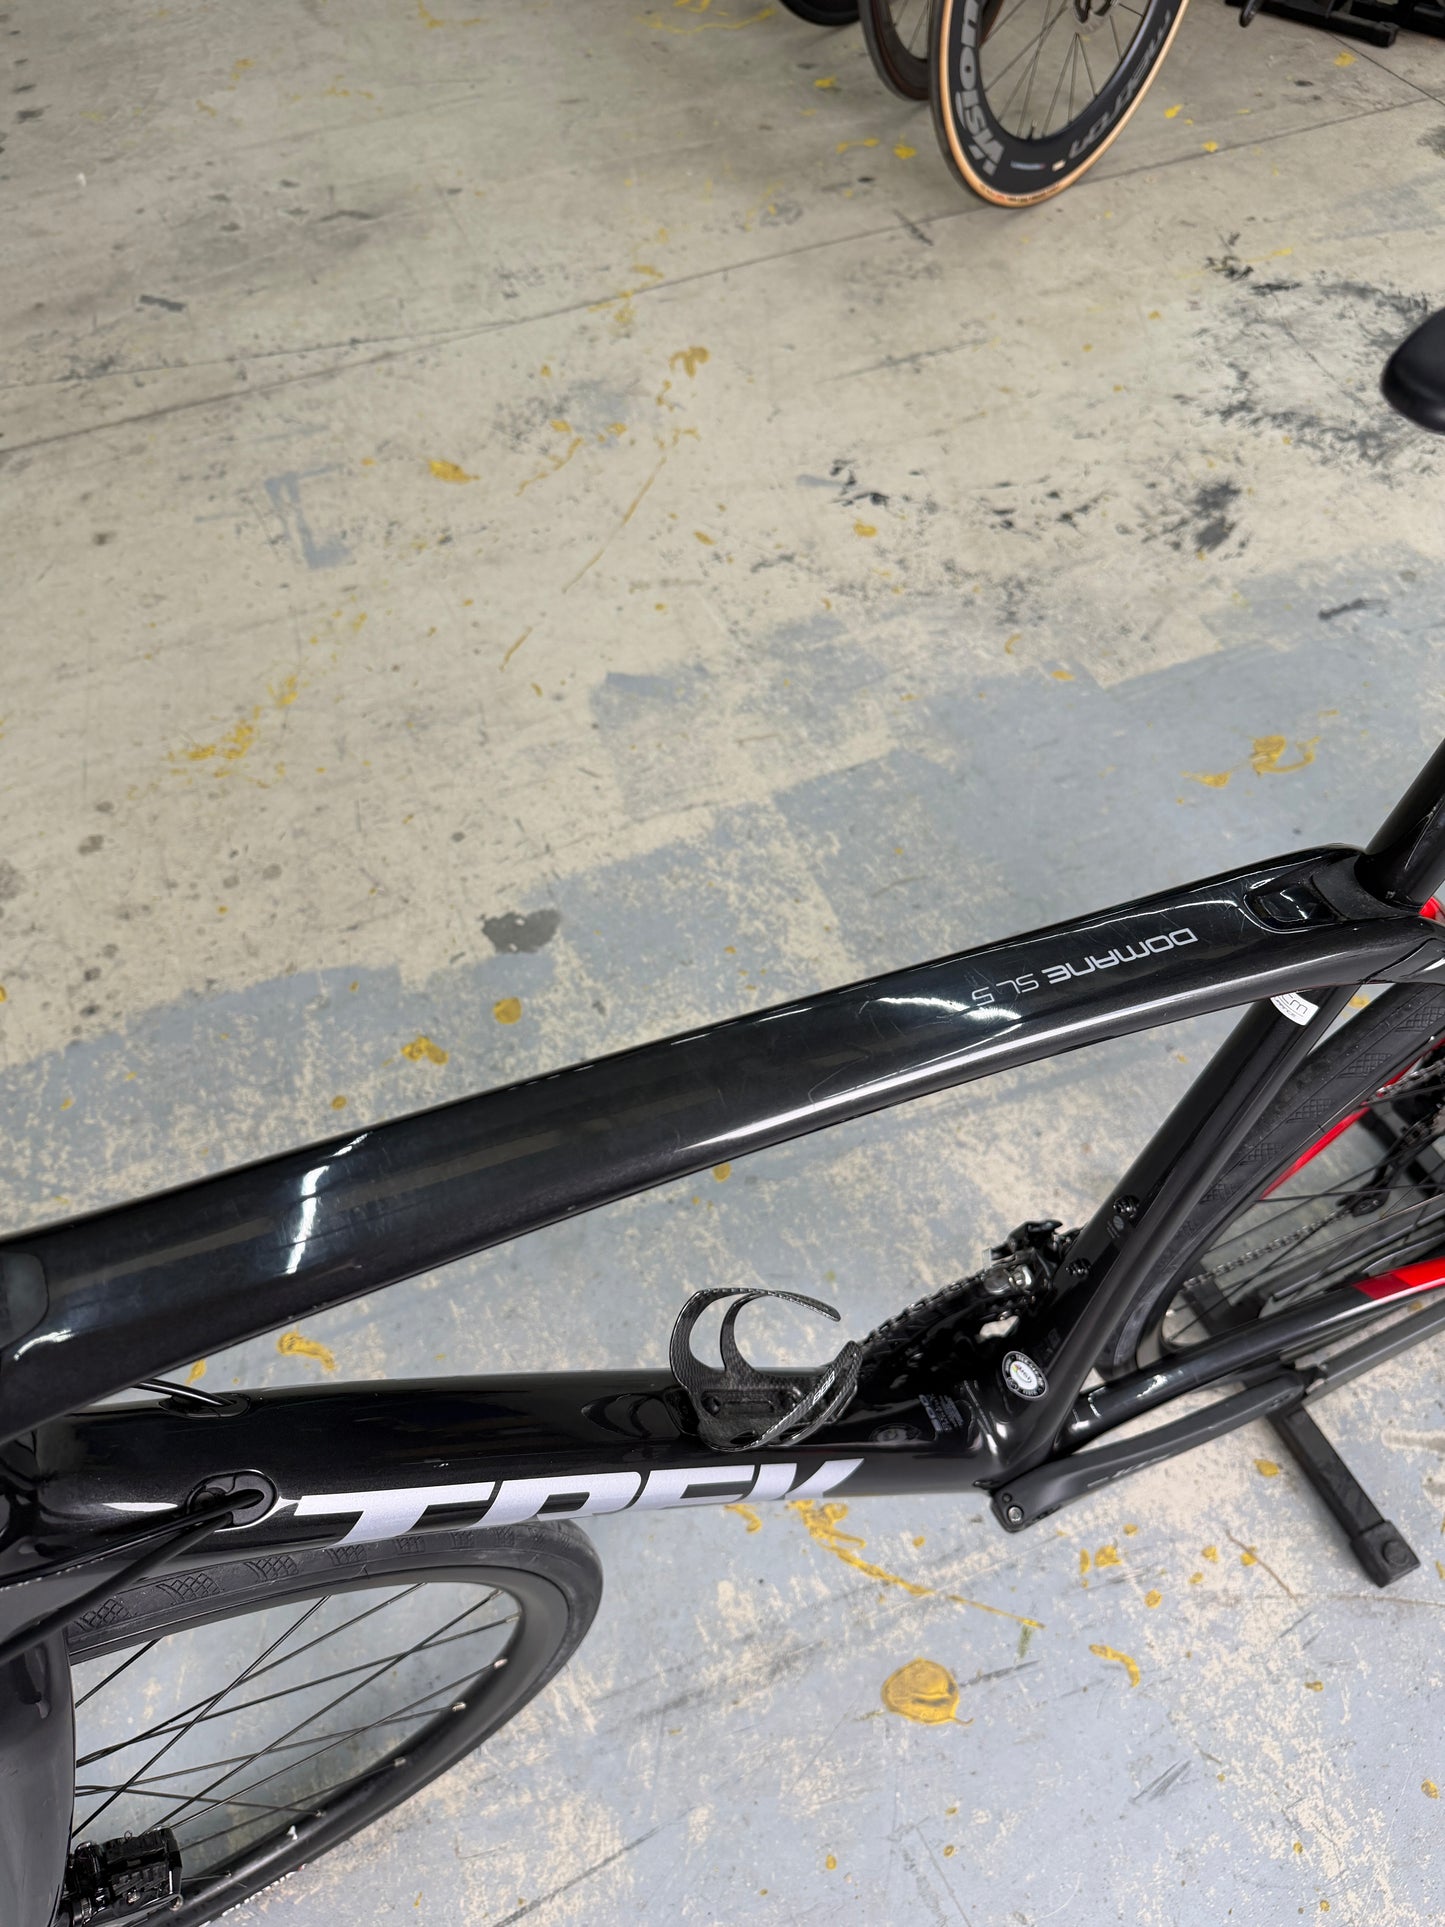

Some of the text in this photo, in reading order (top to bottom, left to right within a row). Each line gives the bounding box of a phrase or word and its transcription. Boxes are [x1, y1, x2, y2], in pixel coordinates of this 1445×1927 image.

[971, 927, 1199, 1006] DOMANE SL 5
[294, 1458, 865, 1545] TREK
